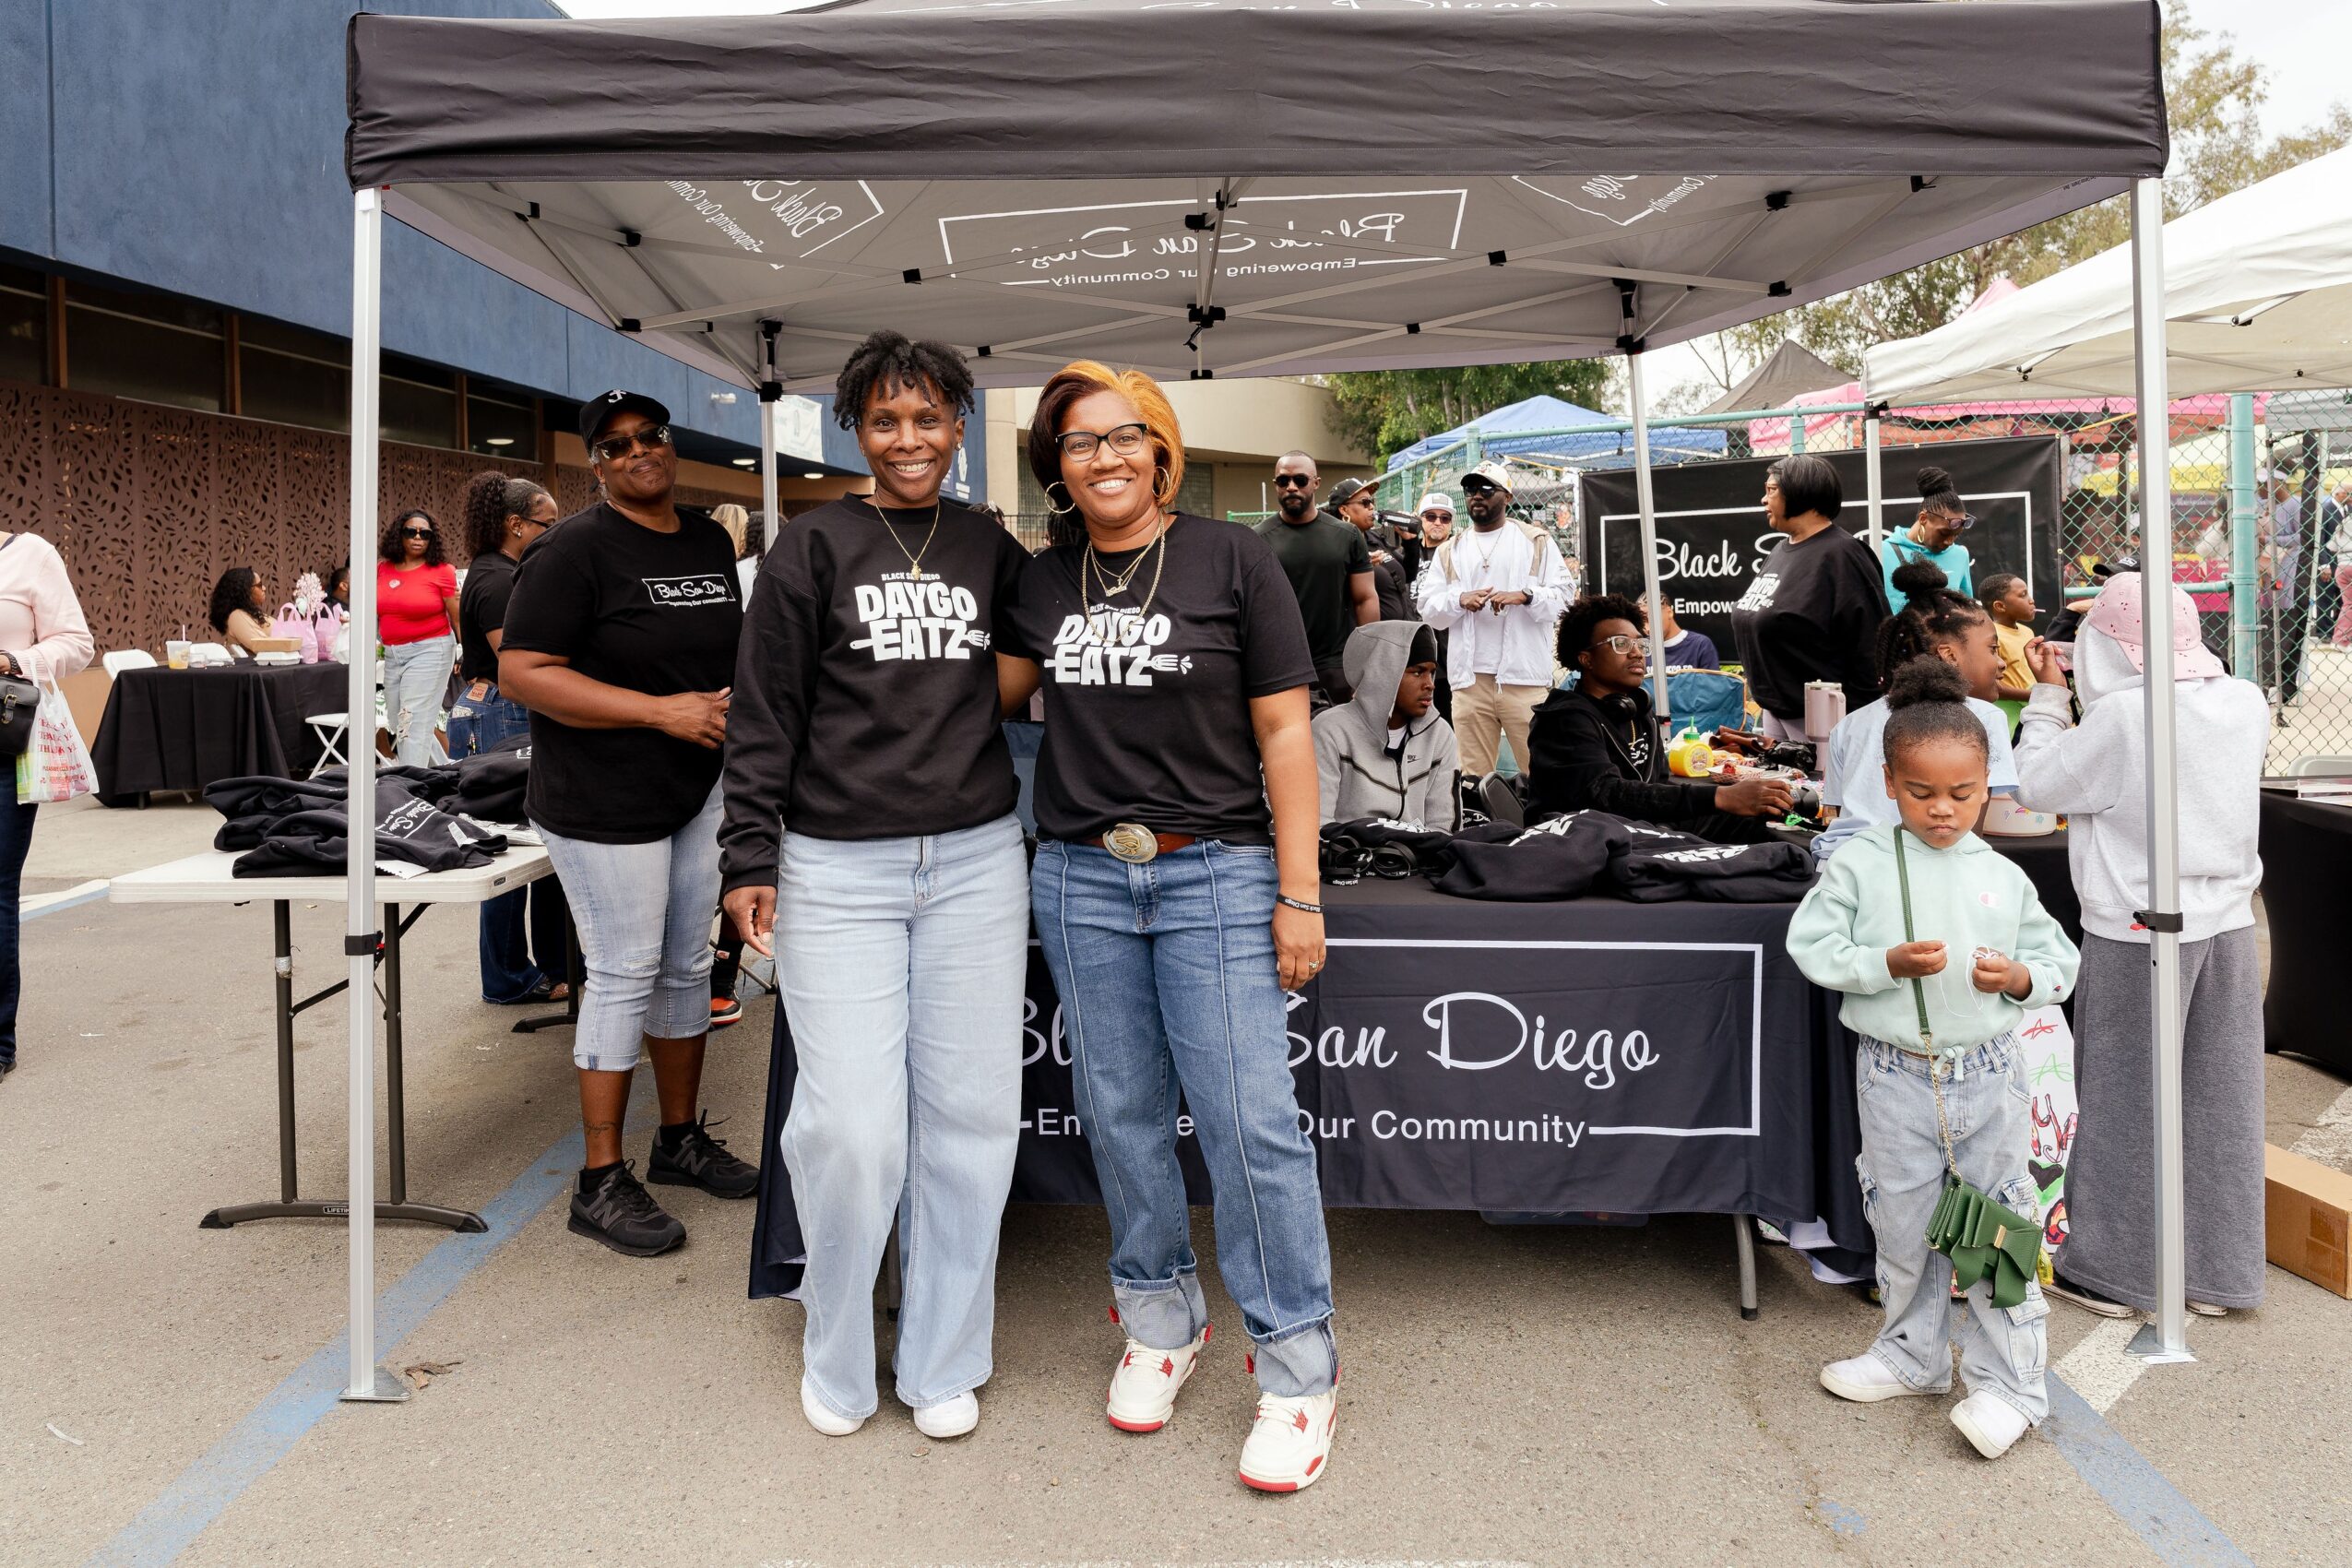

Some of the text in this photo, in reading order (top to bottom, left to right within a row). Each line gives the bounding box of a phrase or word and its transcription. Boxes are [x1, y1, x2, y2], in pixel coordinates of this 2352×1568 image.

[881, 572, 906, 581] BLACK
[921, 573, 941, 581] DIEGO
[854, 581, 979, 624] DAYGO
[1119, 606, 1141, 614] DIEGO
[1674, 598, 1733, 617] Empow
[868, 617, 971, 661] EATZ
[1052, 611, 1171, 647] DAYGO
[1054, 644, 1153, 687] EATZ
[1422, 991, 1661, 1090] Diego
[1372, 1110, 1586, 1148] Community
